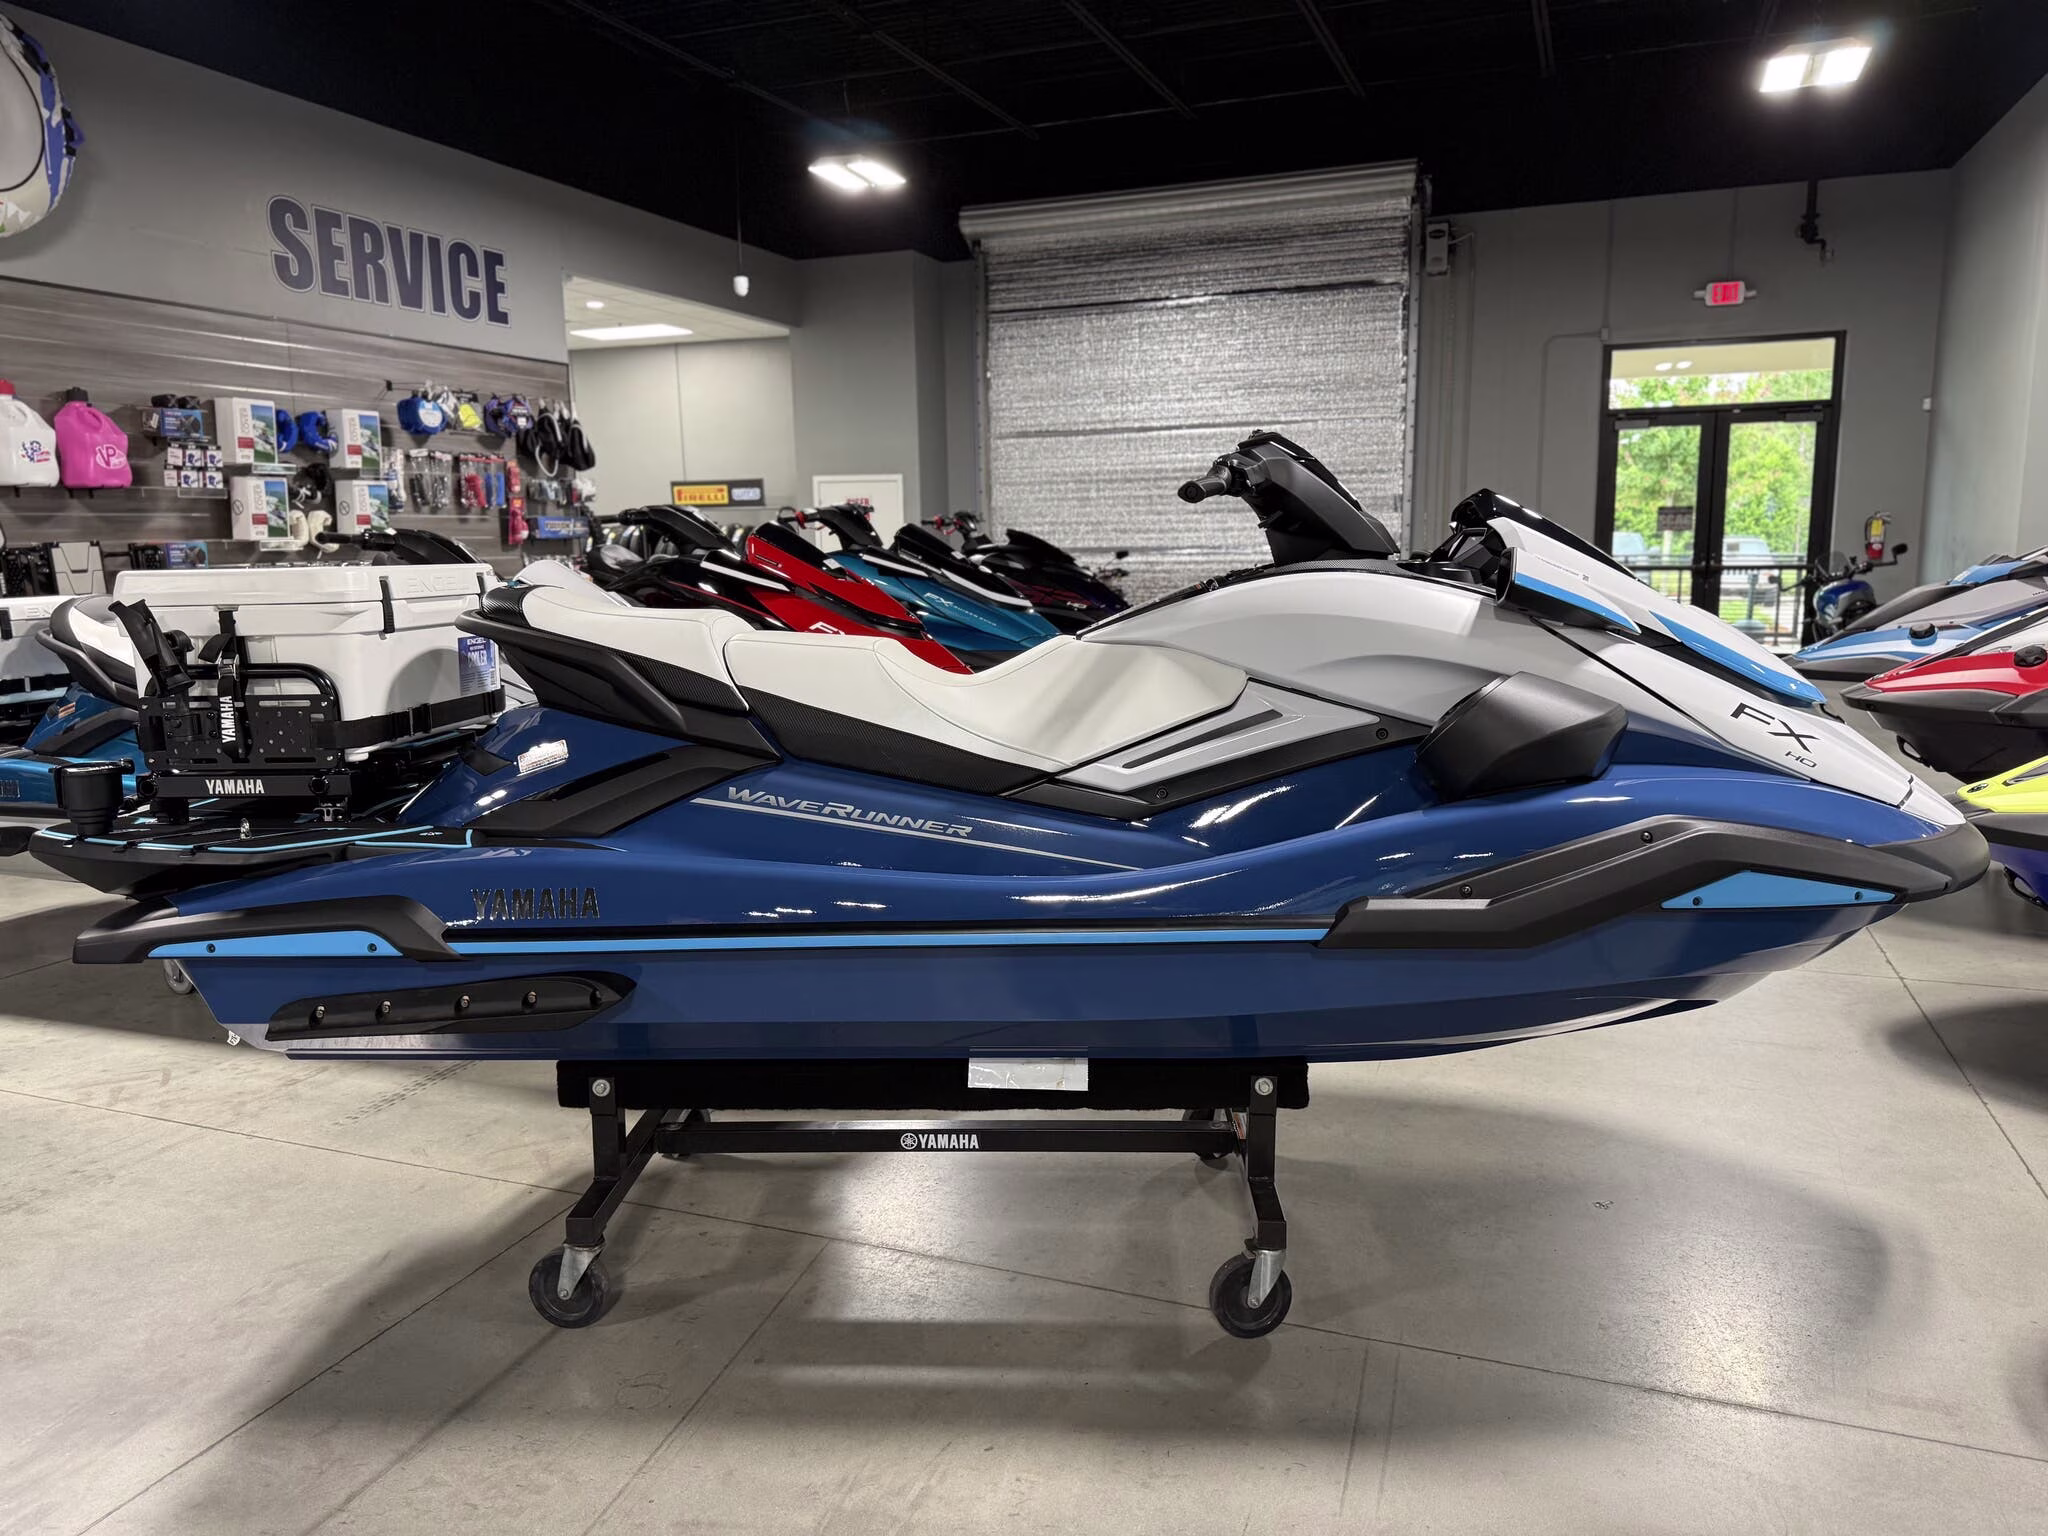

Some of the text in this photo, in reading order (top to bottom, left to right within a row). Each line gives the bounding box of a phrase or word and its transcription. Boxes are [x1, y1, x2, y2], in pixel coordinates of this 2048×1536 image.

[267, 194, 512, 328] SERVICE
[1712, 283, 1739, 303] EXIT
[676, 488, 726, 502] PIRELLI
[809, 621, 846, 635] F
[219, 695, 237, 744] YAMAHA
[1730, 702, 1822, 754] FX
[1784, 750, 1818, 768] HO
[205, 779, 265, 795] YAMAHA
[728, 786, 974, 837] WAVERUNNER
[470, 887, 601, 921] YAMAHA
[918, 1133, 979, 1150] YAMAHA
